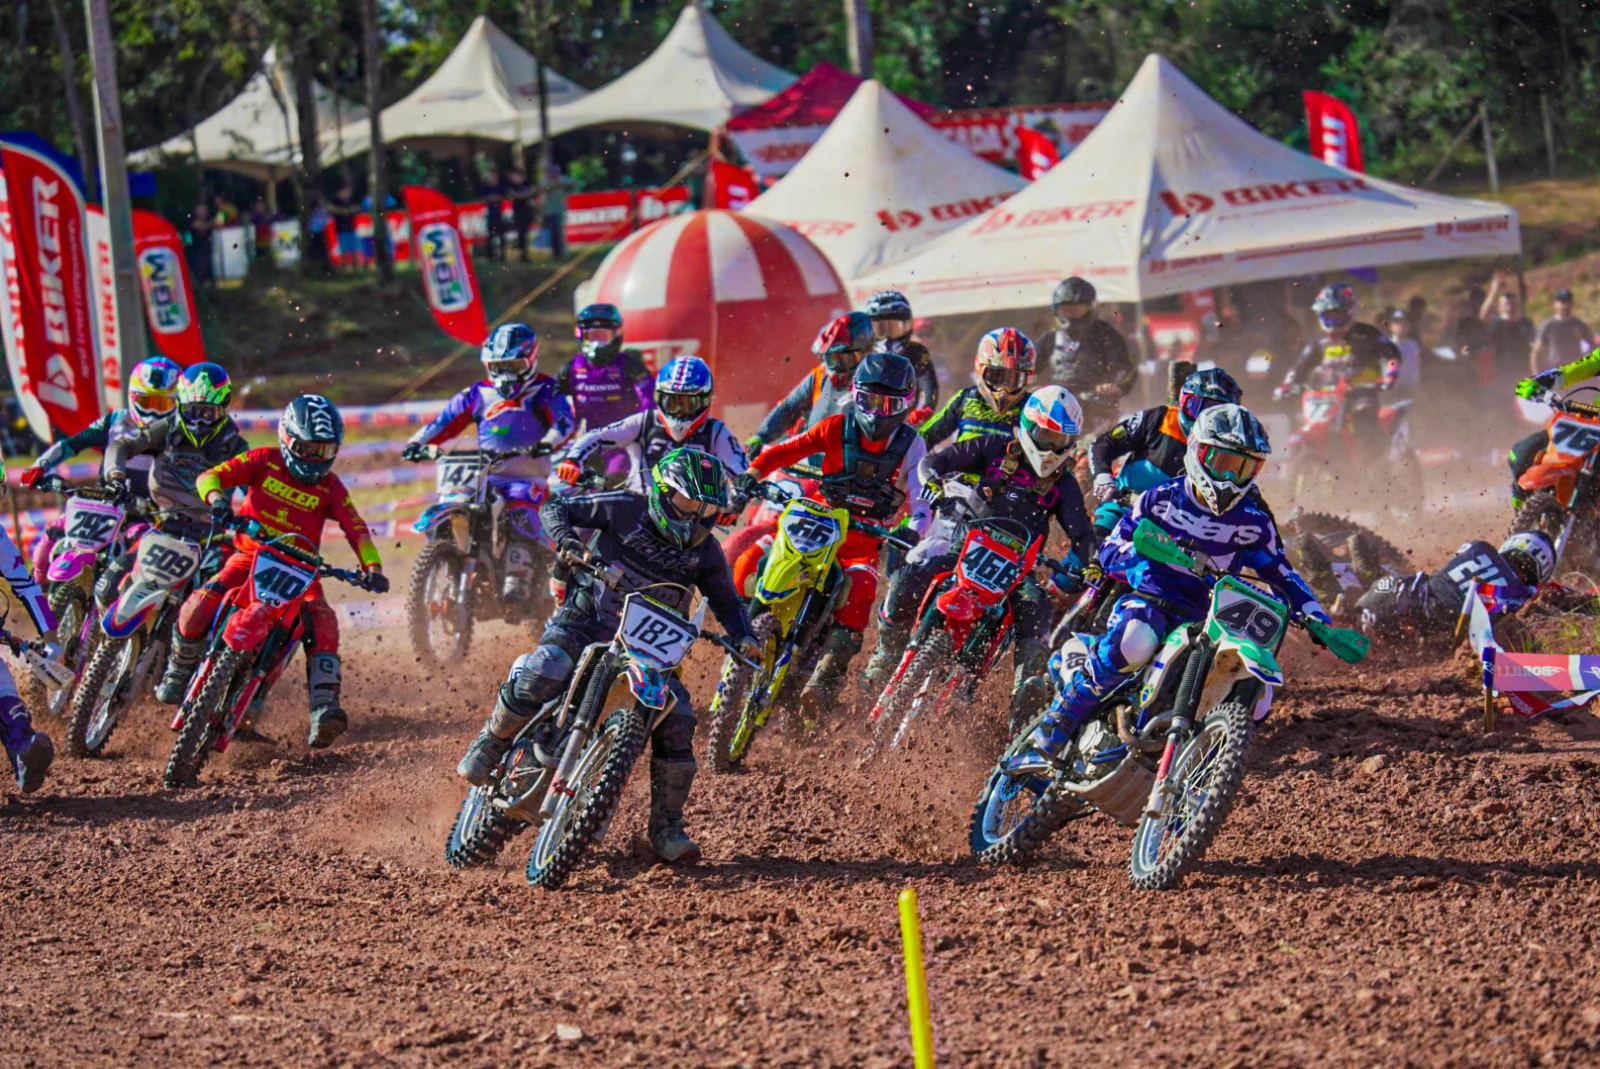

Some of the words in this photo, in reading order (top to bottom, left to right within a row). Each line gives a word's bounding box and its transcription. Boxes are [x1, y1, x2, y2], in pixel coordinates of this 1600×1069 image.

[931, 190, 1018, 221] BIK
[1222, 178, 1372, 206] BIKER
[783, 221, 855, 236] KER
[1017, 200, 1135, 228] BIKER
[33, 175, 70, 345] BIKER
[262, 475, 320, 509] RACER
[440, 465, 485, 486] 147
[67, 511, 118, 543] 292
[1151, 500, 1262, 545] astars
[141, 544, 194, 578] 509
[253, 566, 306, 600] 410
[629, 615, 684, 655] 182
[1214, 599, 1282, 646] 49
[1066, 651, 1087, 670] 49
